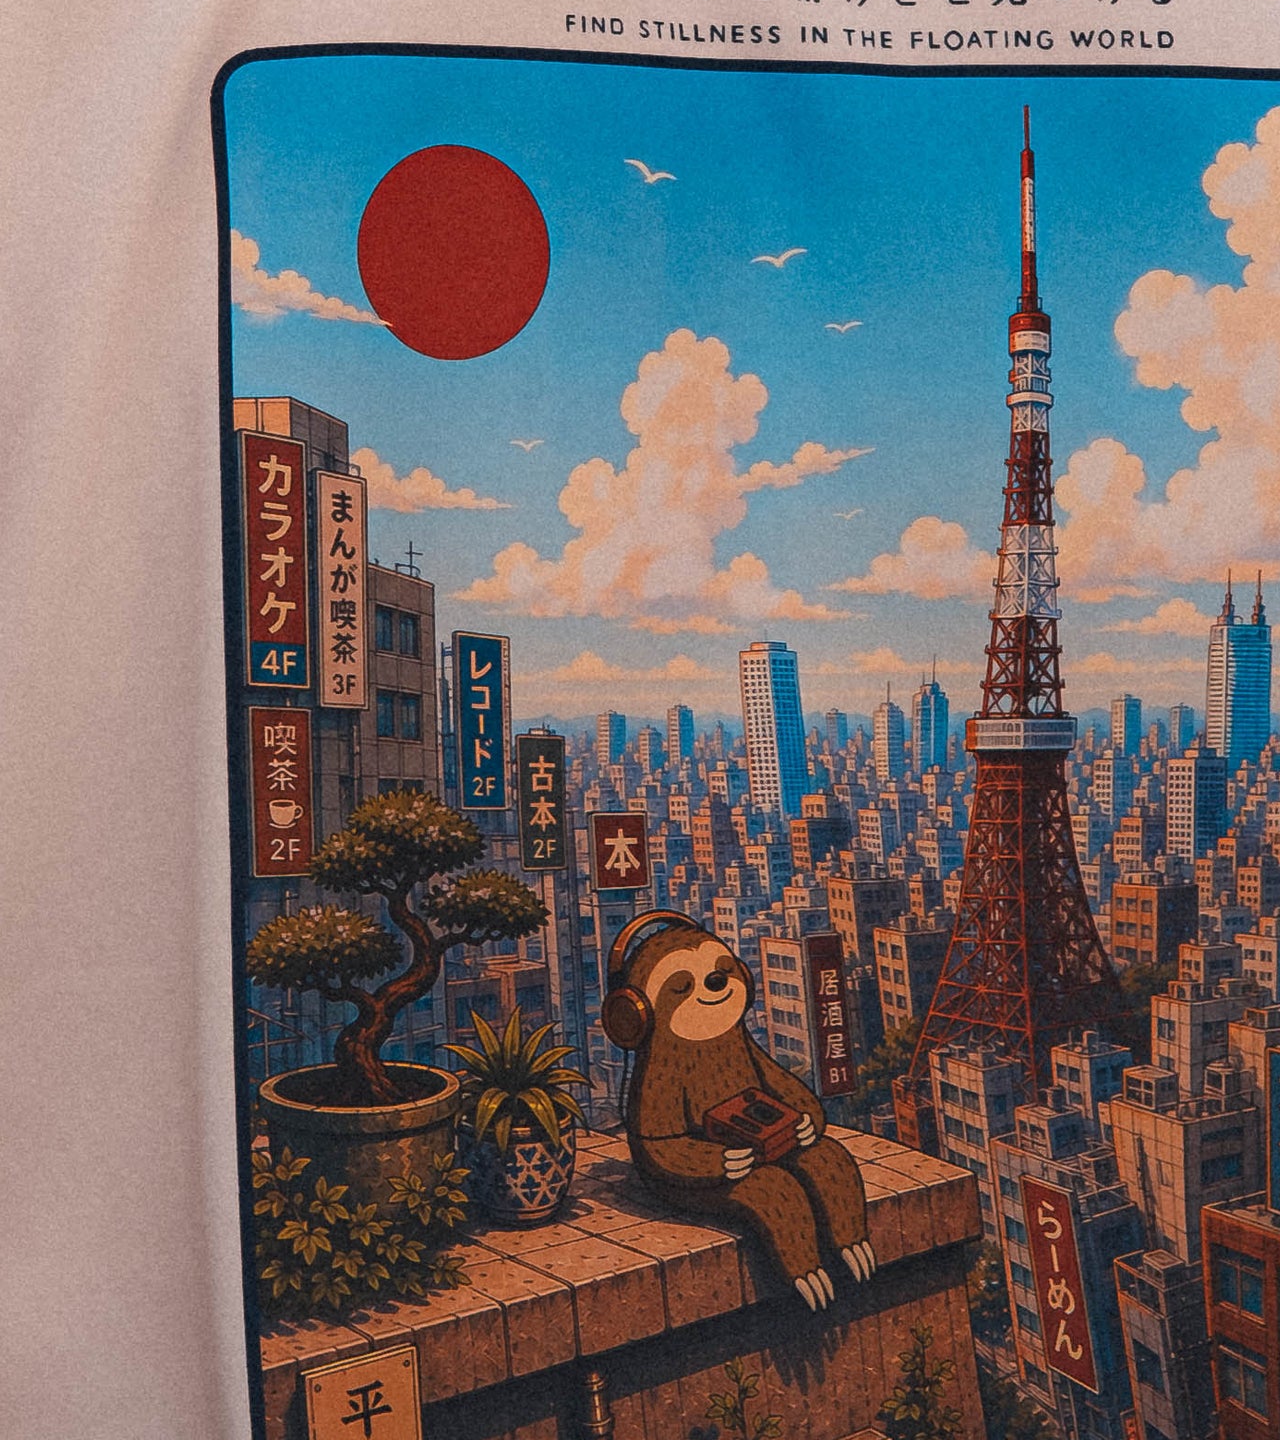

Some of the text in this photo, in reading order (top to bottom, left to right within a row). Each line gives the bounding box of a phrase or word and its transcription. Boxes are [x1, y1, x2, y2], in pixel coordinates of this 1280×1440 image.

[565, 14, 1175, 52] FIND STILLNESS IN THE FLOATING WORLD
[258, 454, 297, 634] カラオケ
[329, 490, 358, 665] まんが喫茶
[260, 649, 297, 676] 4F
[332, 673, 357, 696] 3F
[470, 650, 492, 769] レコード
[264, 721, 298, 791] 喫茶
[472, 776, 496, 797] 2F
[528, 754, 557, 832] 古本
[270, 838, 301, 861] 2F
[533, 838, 557, 859] 2F
[604, 828, 641, 878] 本
[818, 968, 847, 1059] 居酒屋
[829, 1066, 847, 1084] B1
[1037, 1203, 1083, 1361] らーめん
